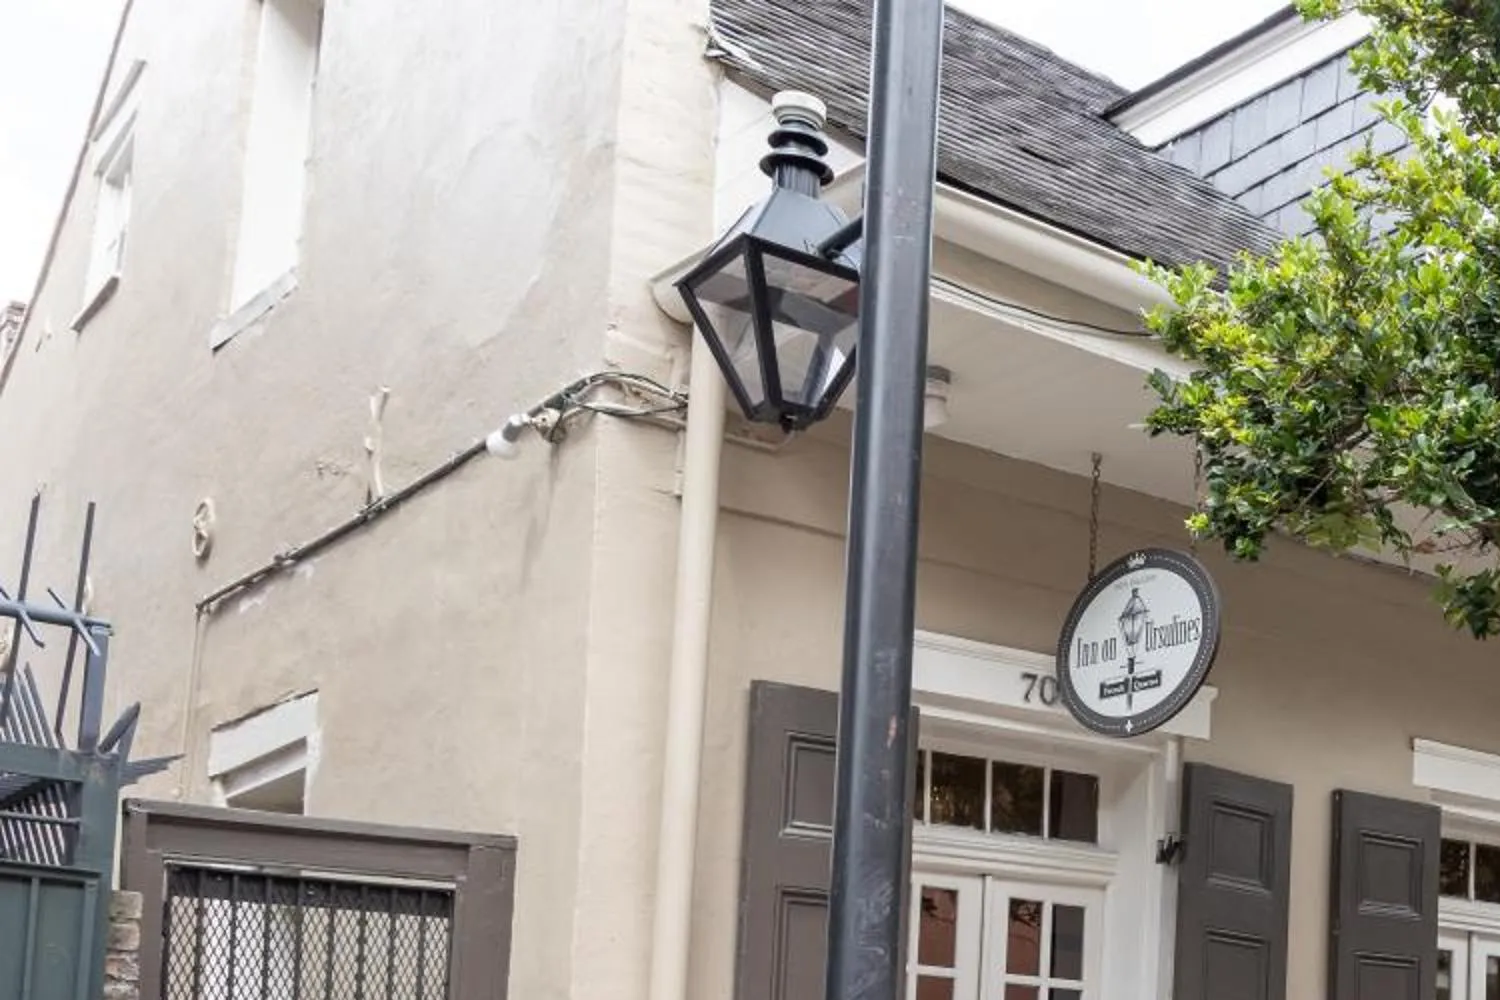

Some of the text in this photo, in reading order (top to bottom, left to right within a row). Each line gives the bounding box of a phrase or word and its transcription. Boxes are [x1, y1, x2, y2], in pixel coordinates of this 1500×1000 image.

[1077, 614, 1201, 668] Inn on Ursulines
[1021, 672, 1059, 706] 70
